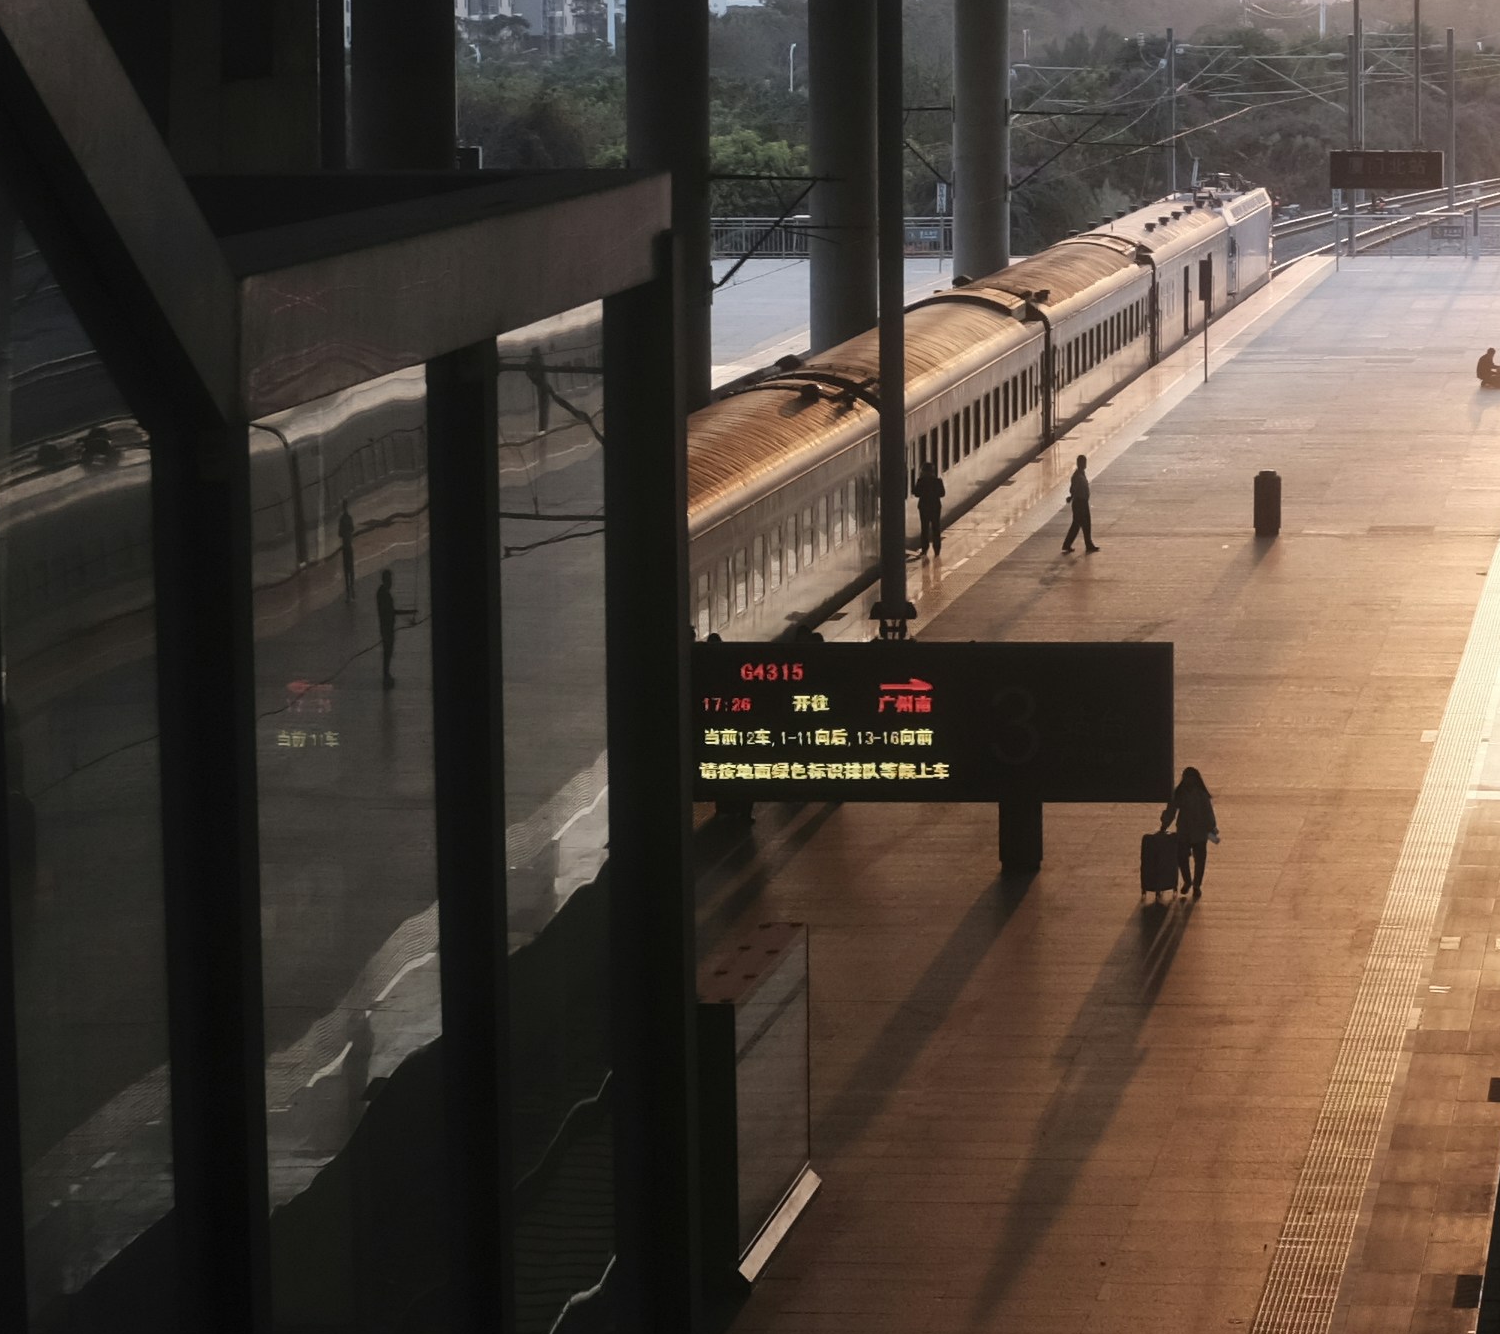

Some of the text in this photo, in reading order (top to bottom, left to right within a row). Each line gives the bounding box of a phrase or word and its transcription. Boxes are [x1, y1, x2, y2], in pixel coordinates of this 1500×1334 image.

[740, 663, 804, 681] G4315
[702, 695, 932, 713] 17:26 开往 广州南
